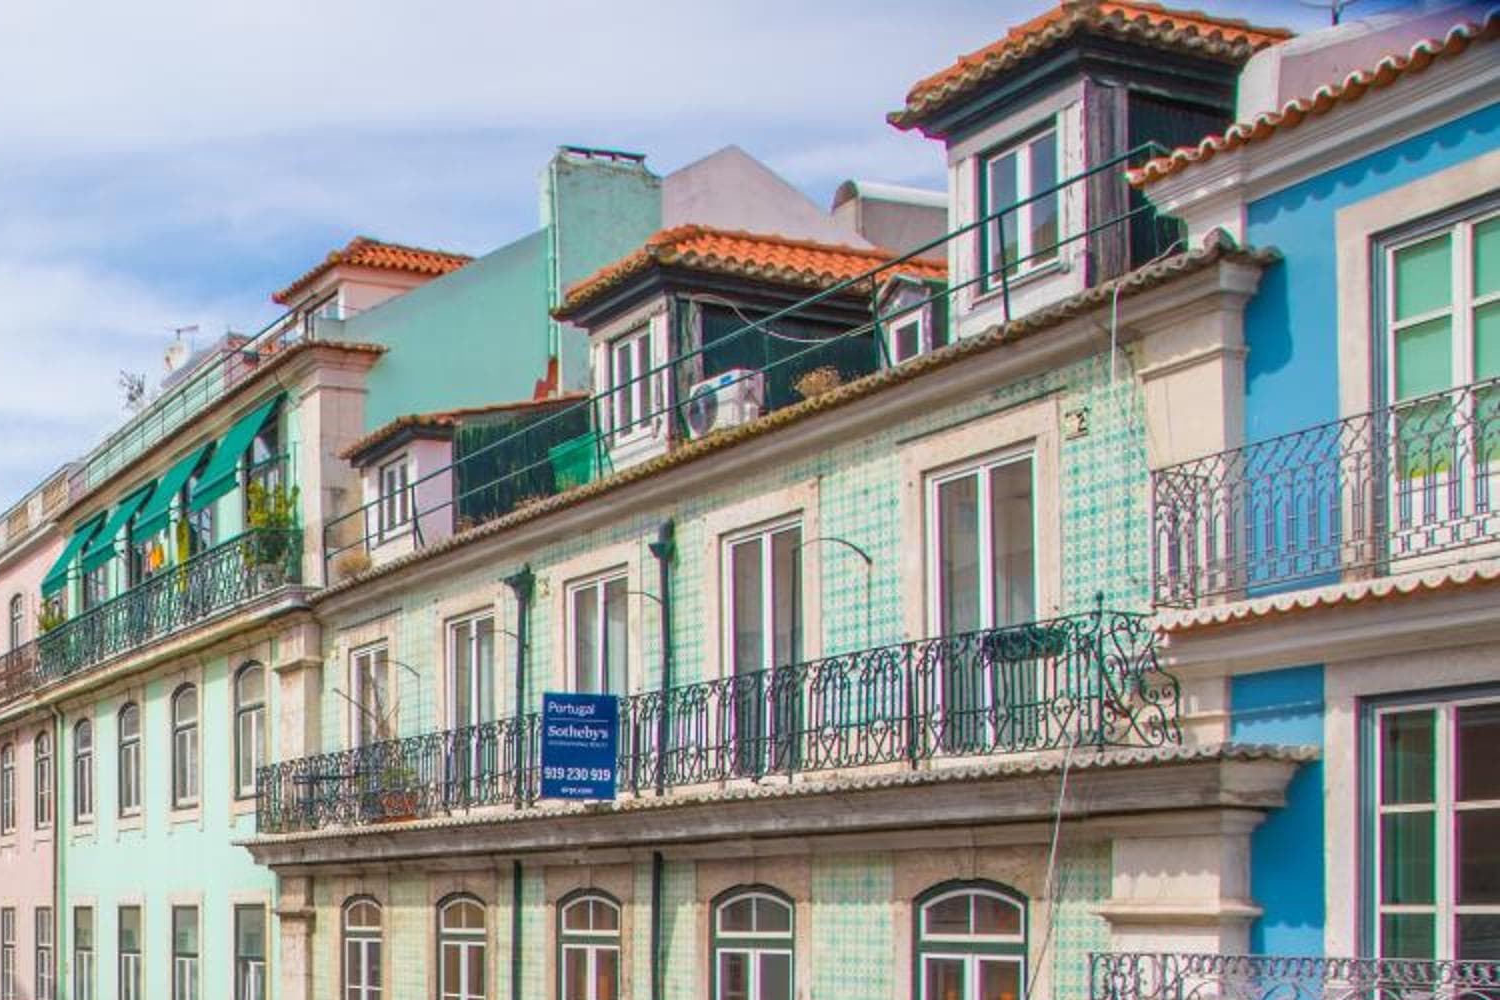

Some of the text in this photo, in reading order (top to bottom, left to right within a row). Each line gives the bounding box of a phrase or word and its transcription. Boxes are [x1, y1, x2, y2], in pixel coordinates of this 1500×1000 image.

[548, 701, 595, 716] Portugal
[544, 767, 611, 781] 919 230 919
